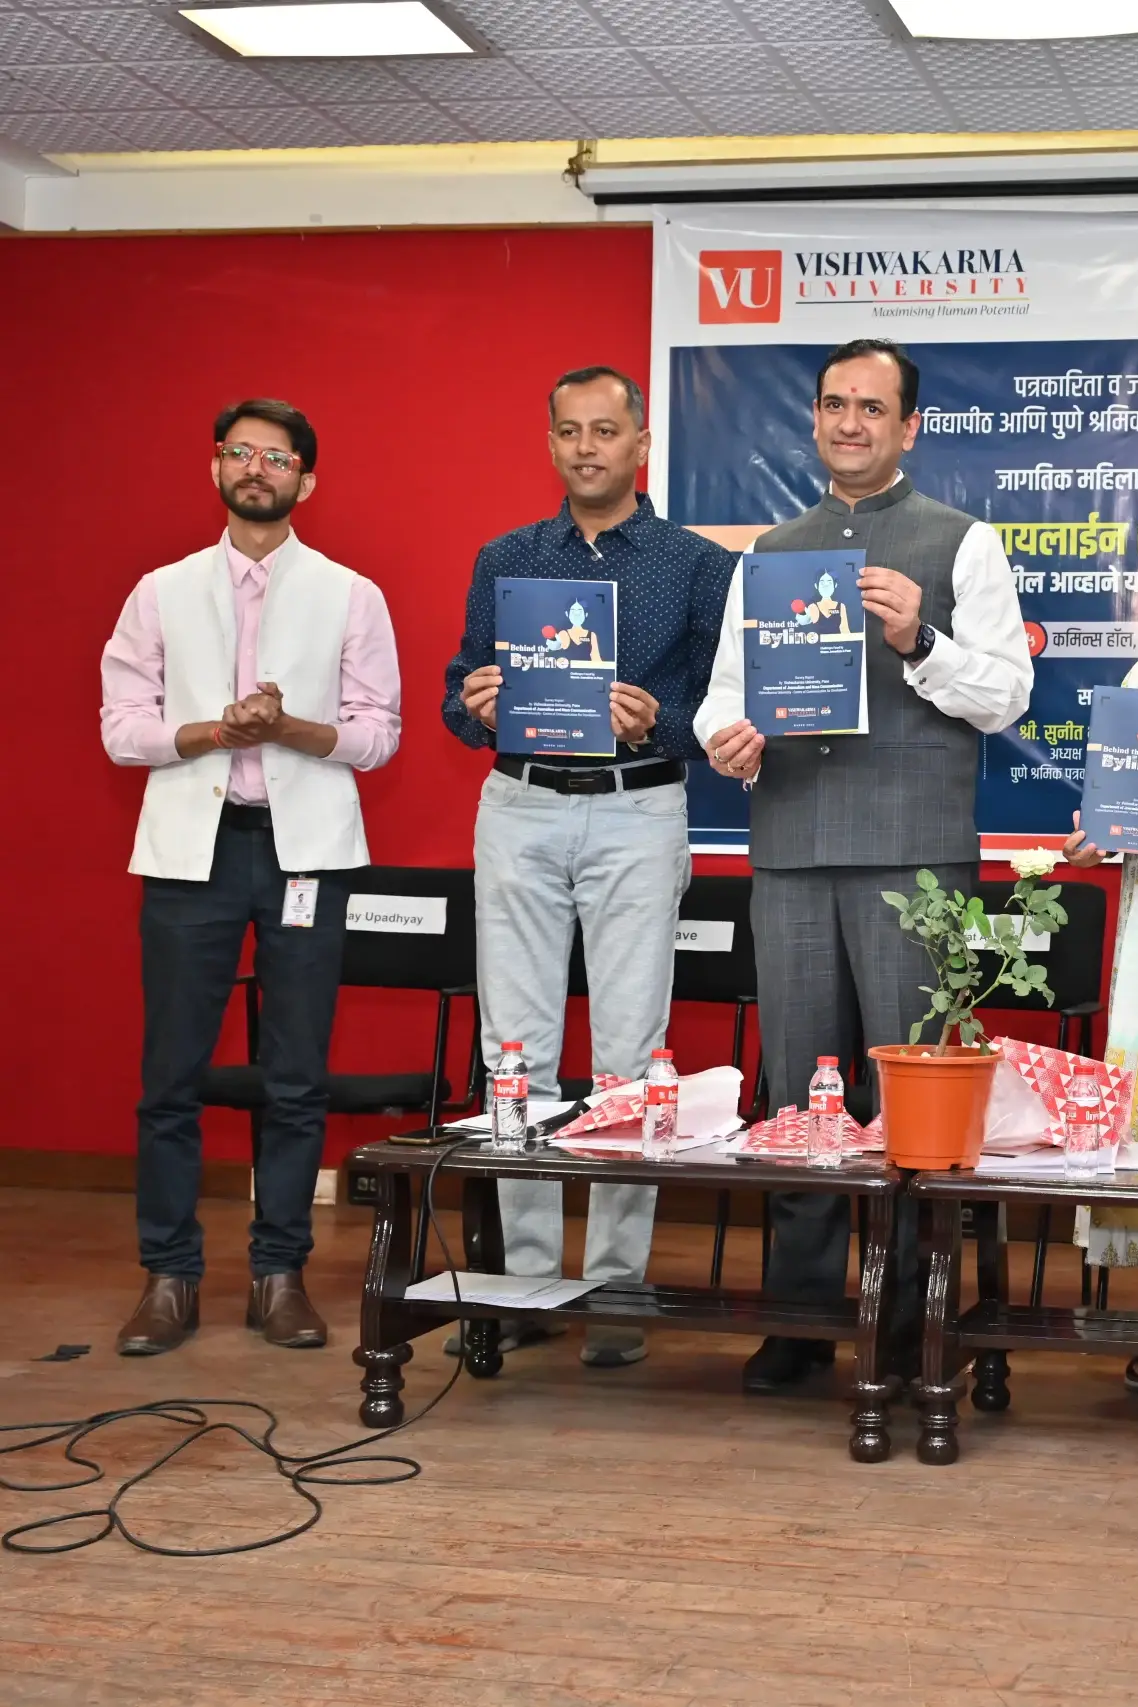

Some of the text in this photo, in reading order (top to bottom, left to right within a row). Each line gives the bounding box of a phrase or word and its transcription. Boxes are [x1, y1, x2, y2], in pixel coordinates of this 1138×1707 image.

[795, 249, 1025, 276] VISHWAKARMA
[706, 267, 774, 309] VU
[799, 277, 1028, 297] UNIVERSITY
[872, 304, 1030, 319] Maximising Human Potential
[1013, 369, 1104, 397] पत्रकारिता
[1107, 374, 1122, 396] व
[922, 406, 994, 434] विद्यापीठ
[999, 405, 1048, 433] आणि
[1051, 405, 1084, 440] पुणे
[995, 462, 1073, 491] जागतिक
[1050, 565, 1121, 593] आव्हाने
[787, 620, 798, 628] the
[510, 644, 550, 652] Behind the
[1052, 628, 1102, 648] कमिन्स
[1106, 628, 1136, 650] हॉल,
[1019, 720, 1084, 745] श्री. सुनीत
[1050, 748, 1082, 760] अध्यक्ष
[1103, 745, 1129, 754] Behind
[1010, 764, 1028, 783] पुणे
[1031, 764, 1062, 780] श्रमिक
[365, 912, 424, 926] Upadhyay
